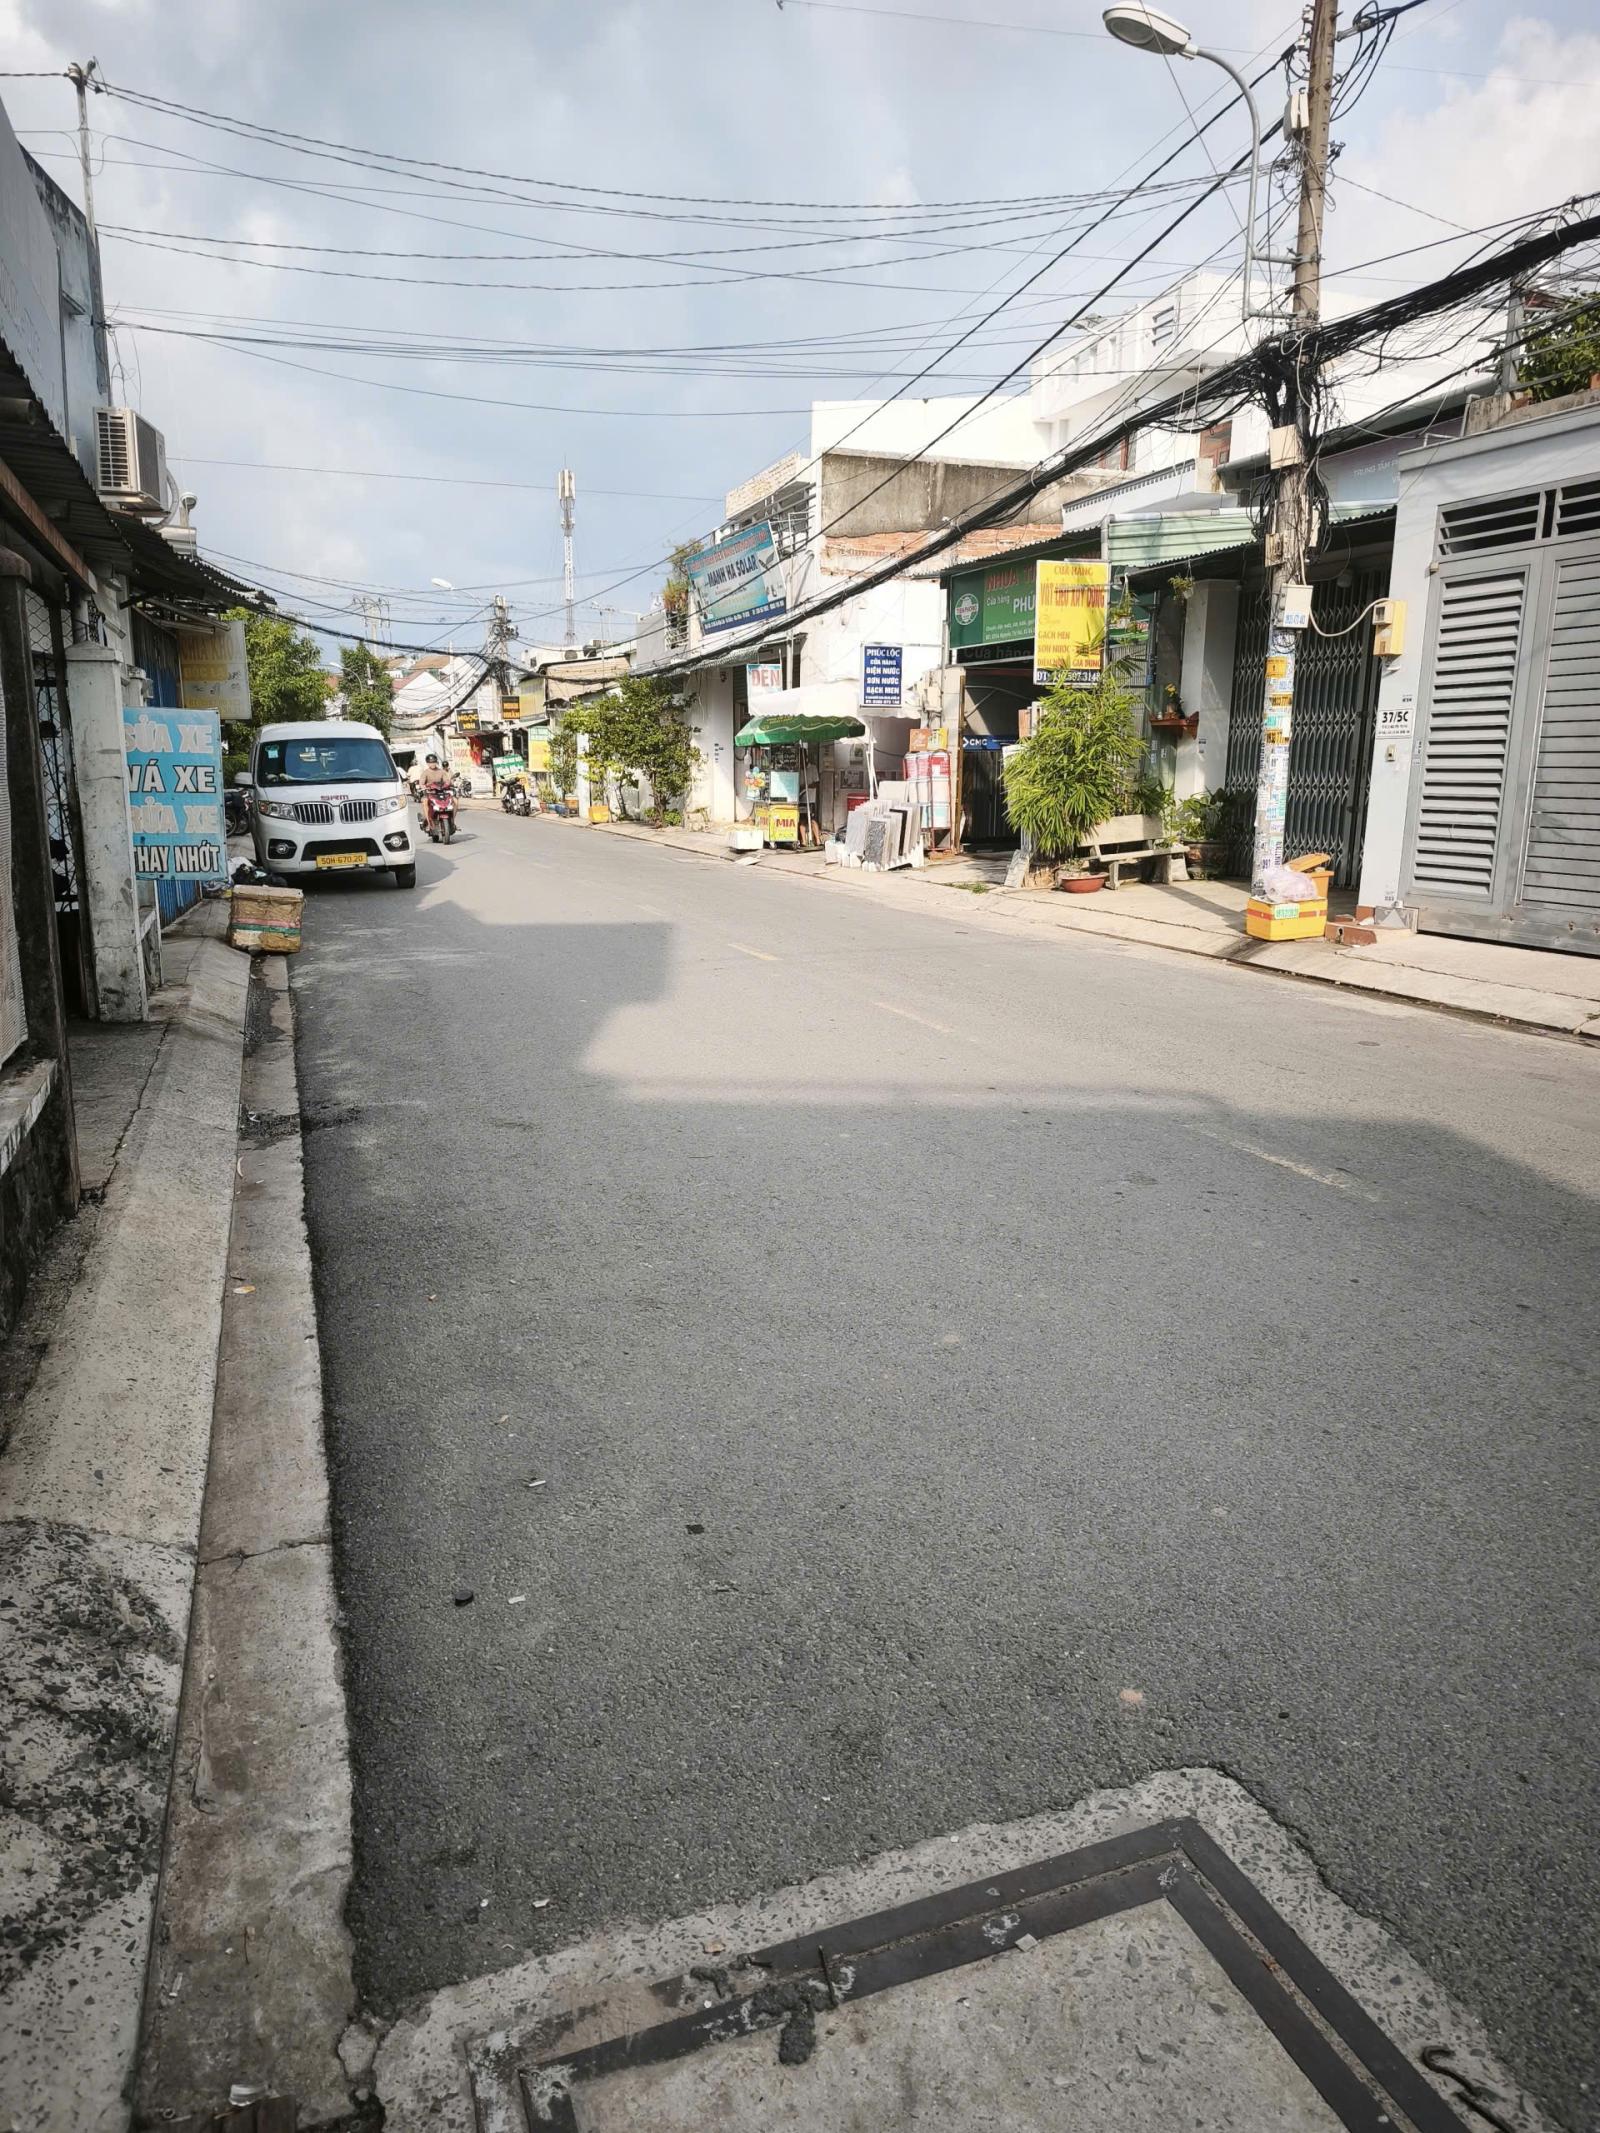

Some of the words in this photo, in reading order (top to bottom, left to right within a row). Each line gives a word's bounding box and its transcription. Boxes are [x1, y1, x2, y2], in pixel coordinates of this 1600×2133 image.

[735, 554, 759, 577] SOLAR
[866, 648, 885, 657] PHÚC
[887, 648, 900, 657] LỘC
[1382, 711, 1409, 723] 37/5C
[176, 724, 213, 753] XE
[969, 738, 988, 746] CMC
[173, 765, 217, 793] XE
[183, 804, 219, 834] XE
[174, 839, 221, 873] NHỚT
